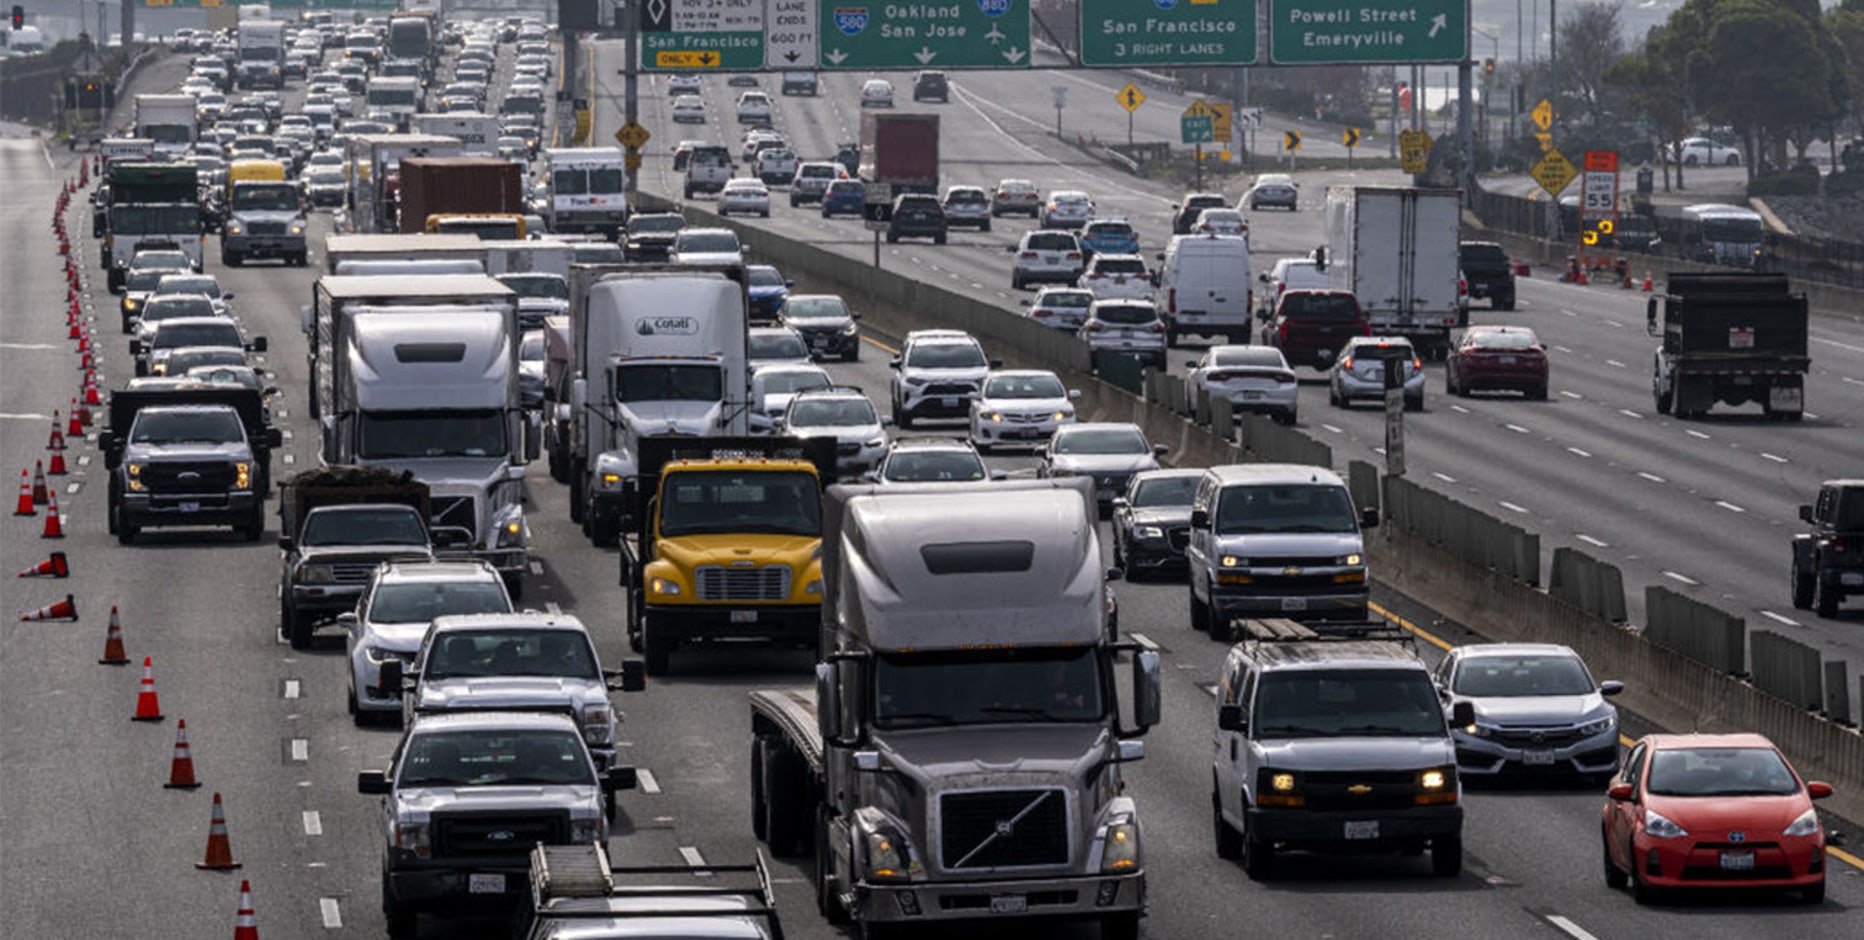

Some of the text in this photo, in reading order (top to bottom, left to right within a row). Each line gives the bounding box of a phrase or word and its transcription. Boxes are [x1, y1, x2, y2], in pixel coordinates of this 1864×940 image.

[776, 2, 806, 12] LANE
[885, 5, 960, 18] Oakland
[776, 16, 807, 25] ENDS
[1290, 8, 1417, 23] Powell Street
[839, 18, 863, 29] 580
[1103, 19, 1236, 33] San Francisco
[881, 24, 967, 37] San Jose
[647, 36, 759, 48] San Francisco
[770, 32, 812, 44] 600 FT
[1303, 31, 1405, 49] Emeryville
[1115, 43, 1226, 56] 3 RIGHT LANES
[661, 53, 692, 63] ONLY
[1588, 193, 1612, 207] 55
[654, 318, 689, 328] Cotati
